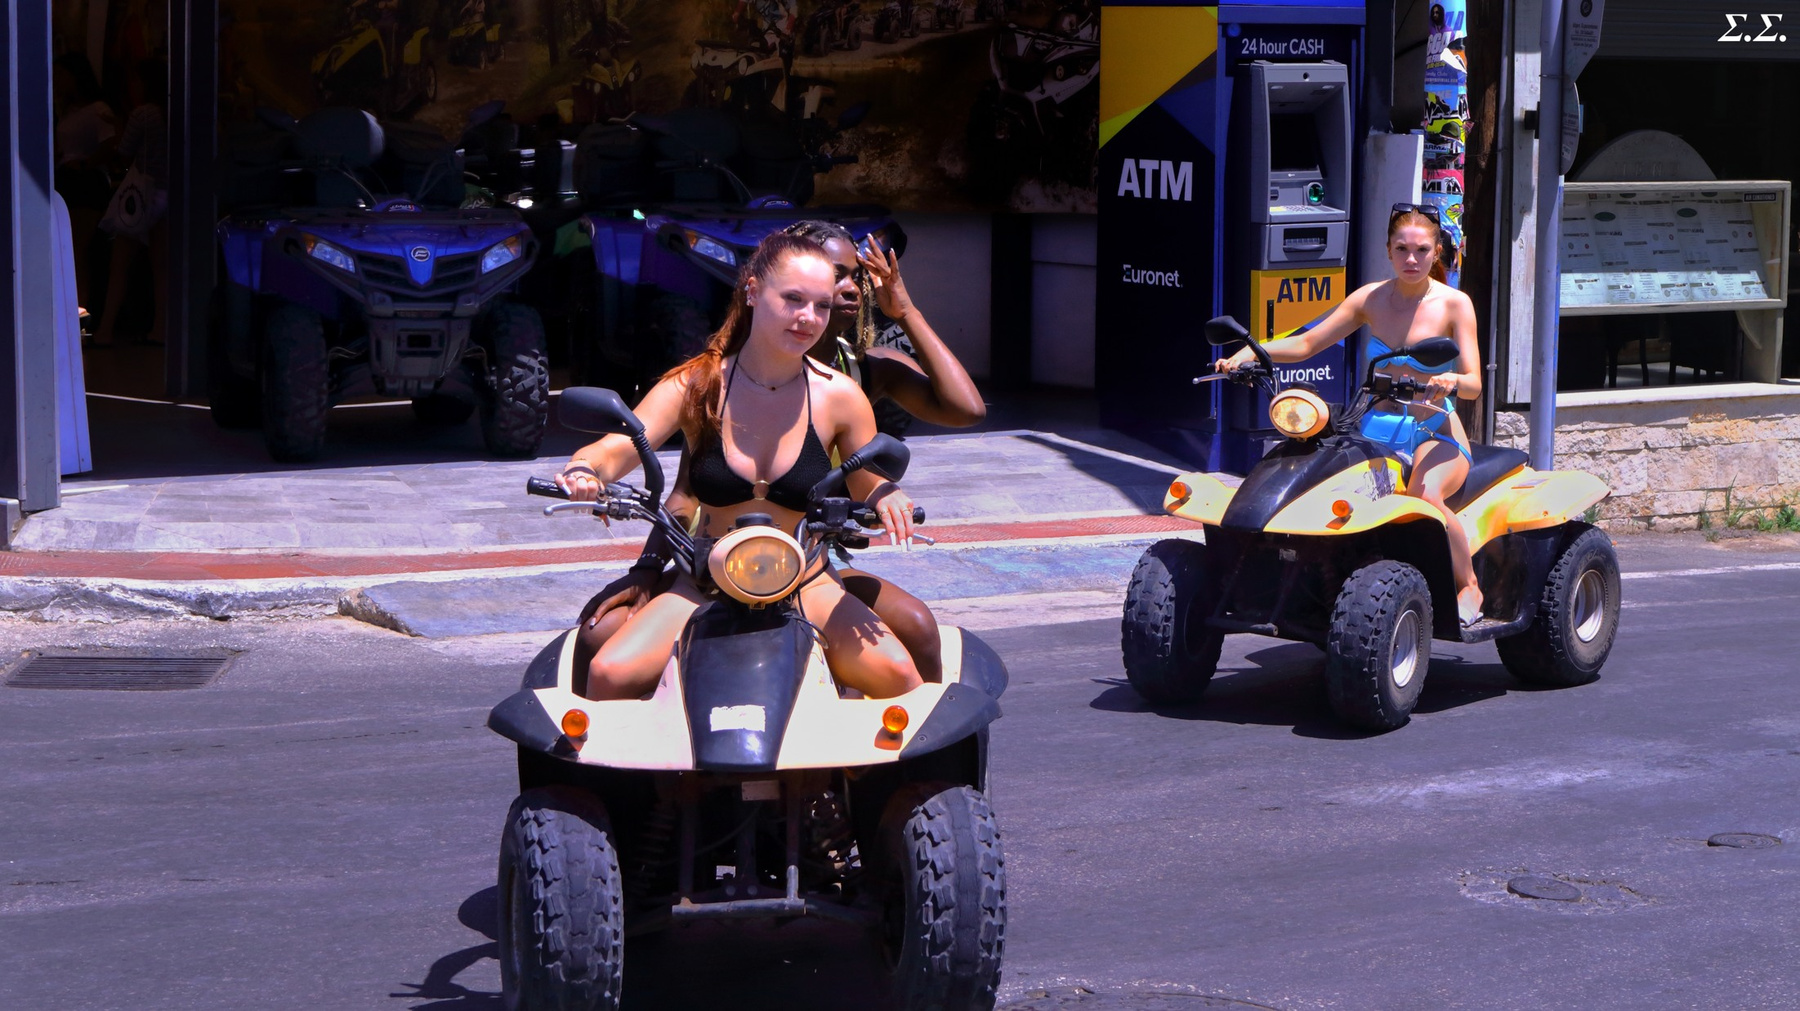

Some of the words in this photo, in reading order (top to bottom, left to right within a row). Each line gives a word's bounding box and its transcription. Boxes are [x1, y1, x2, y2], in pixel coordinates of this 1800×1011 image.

[1241, 38, 1257, 54] 24
[1260, 37, 1287, 54] hour
[1289, 38, 1324, 55] CASH
[1117, 158, 1193, 202] ATM
[1122, 264, 1181, 288] Euronet
[1276, 276, 1331, 303] ATM
